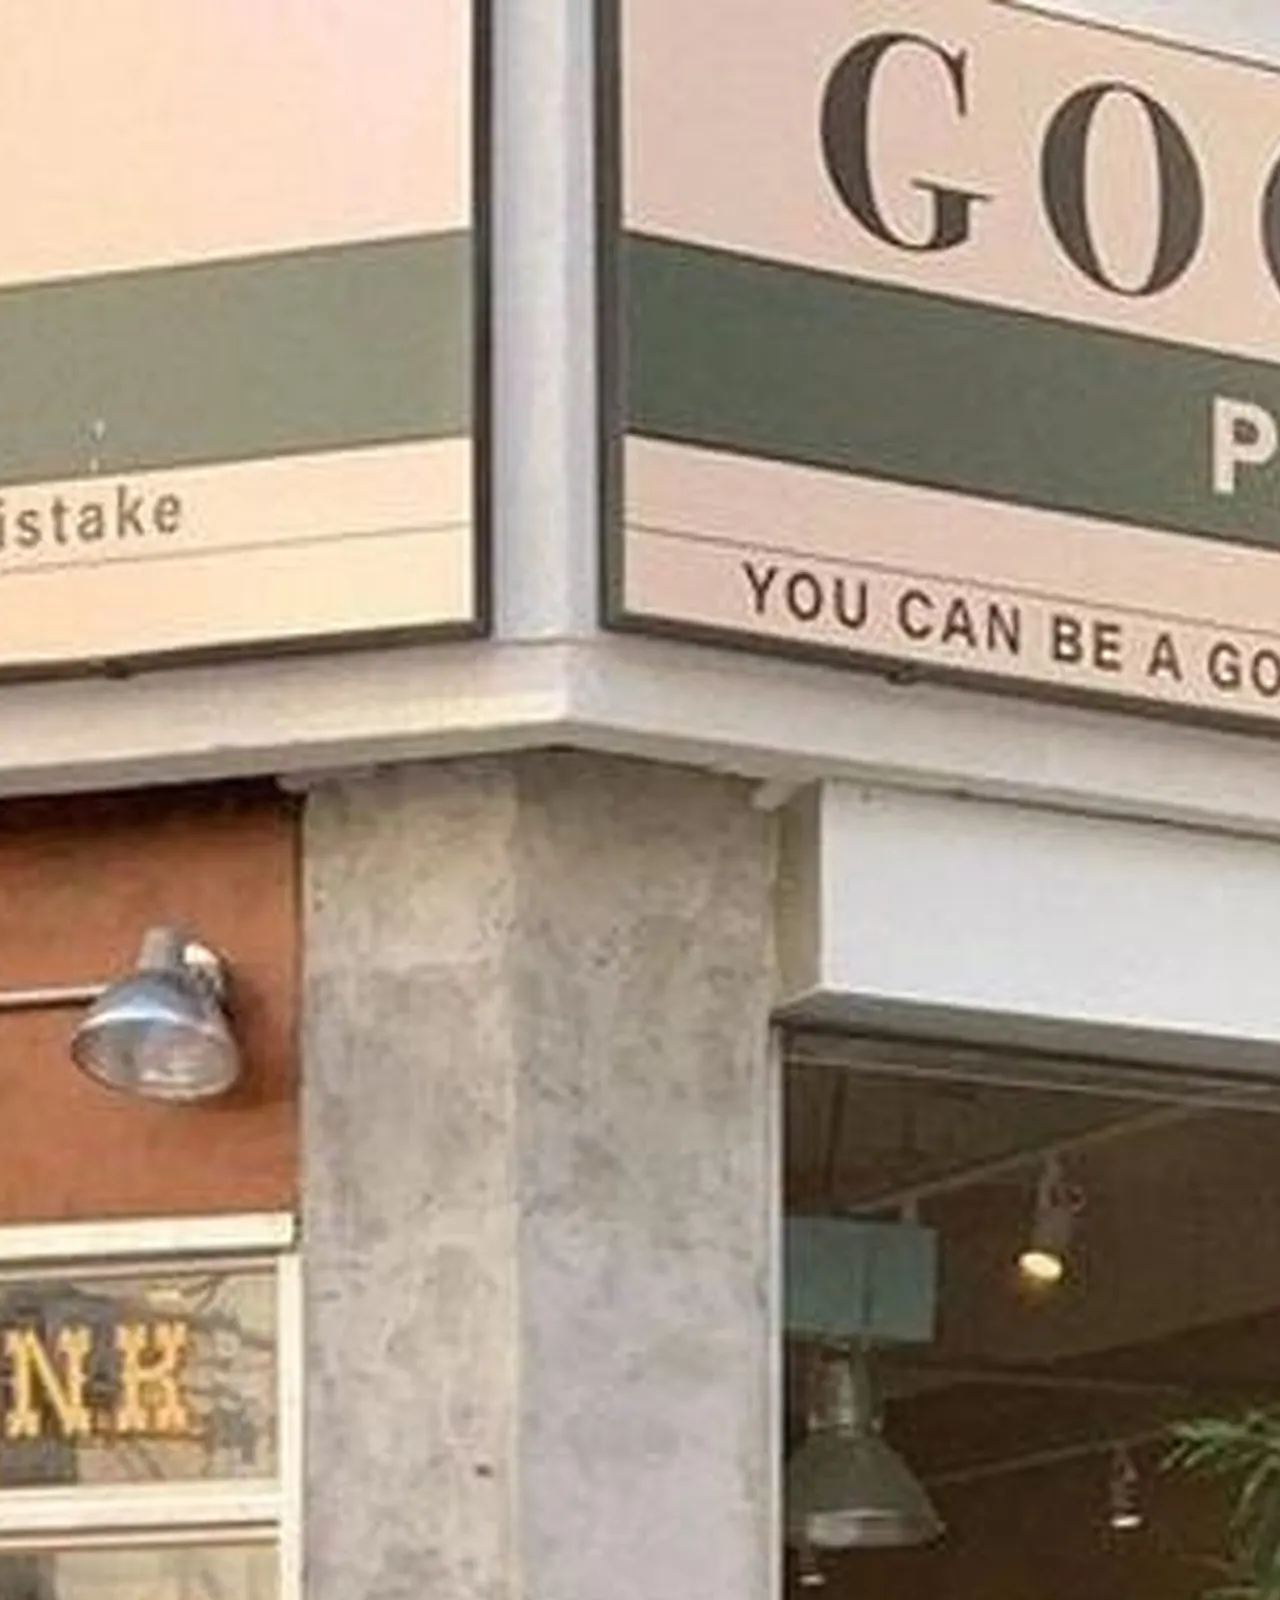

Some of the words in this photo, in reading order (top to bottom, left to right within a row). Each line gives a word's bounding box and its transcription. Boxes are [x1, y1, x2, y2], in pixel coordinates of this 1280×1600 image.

[743, 561, 870, 631] YOU
[897, 590, 1023, 657] CAN
[1052, 613, 1123, 672] BE
[1147, 631, 1184, 681] A
